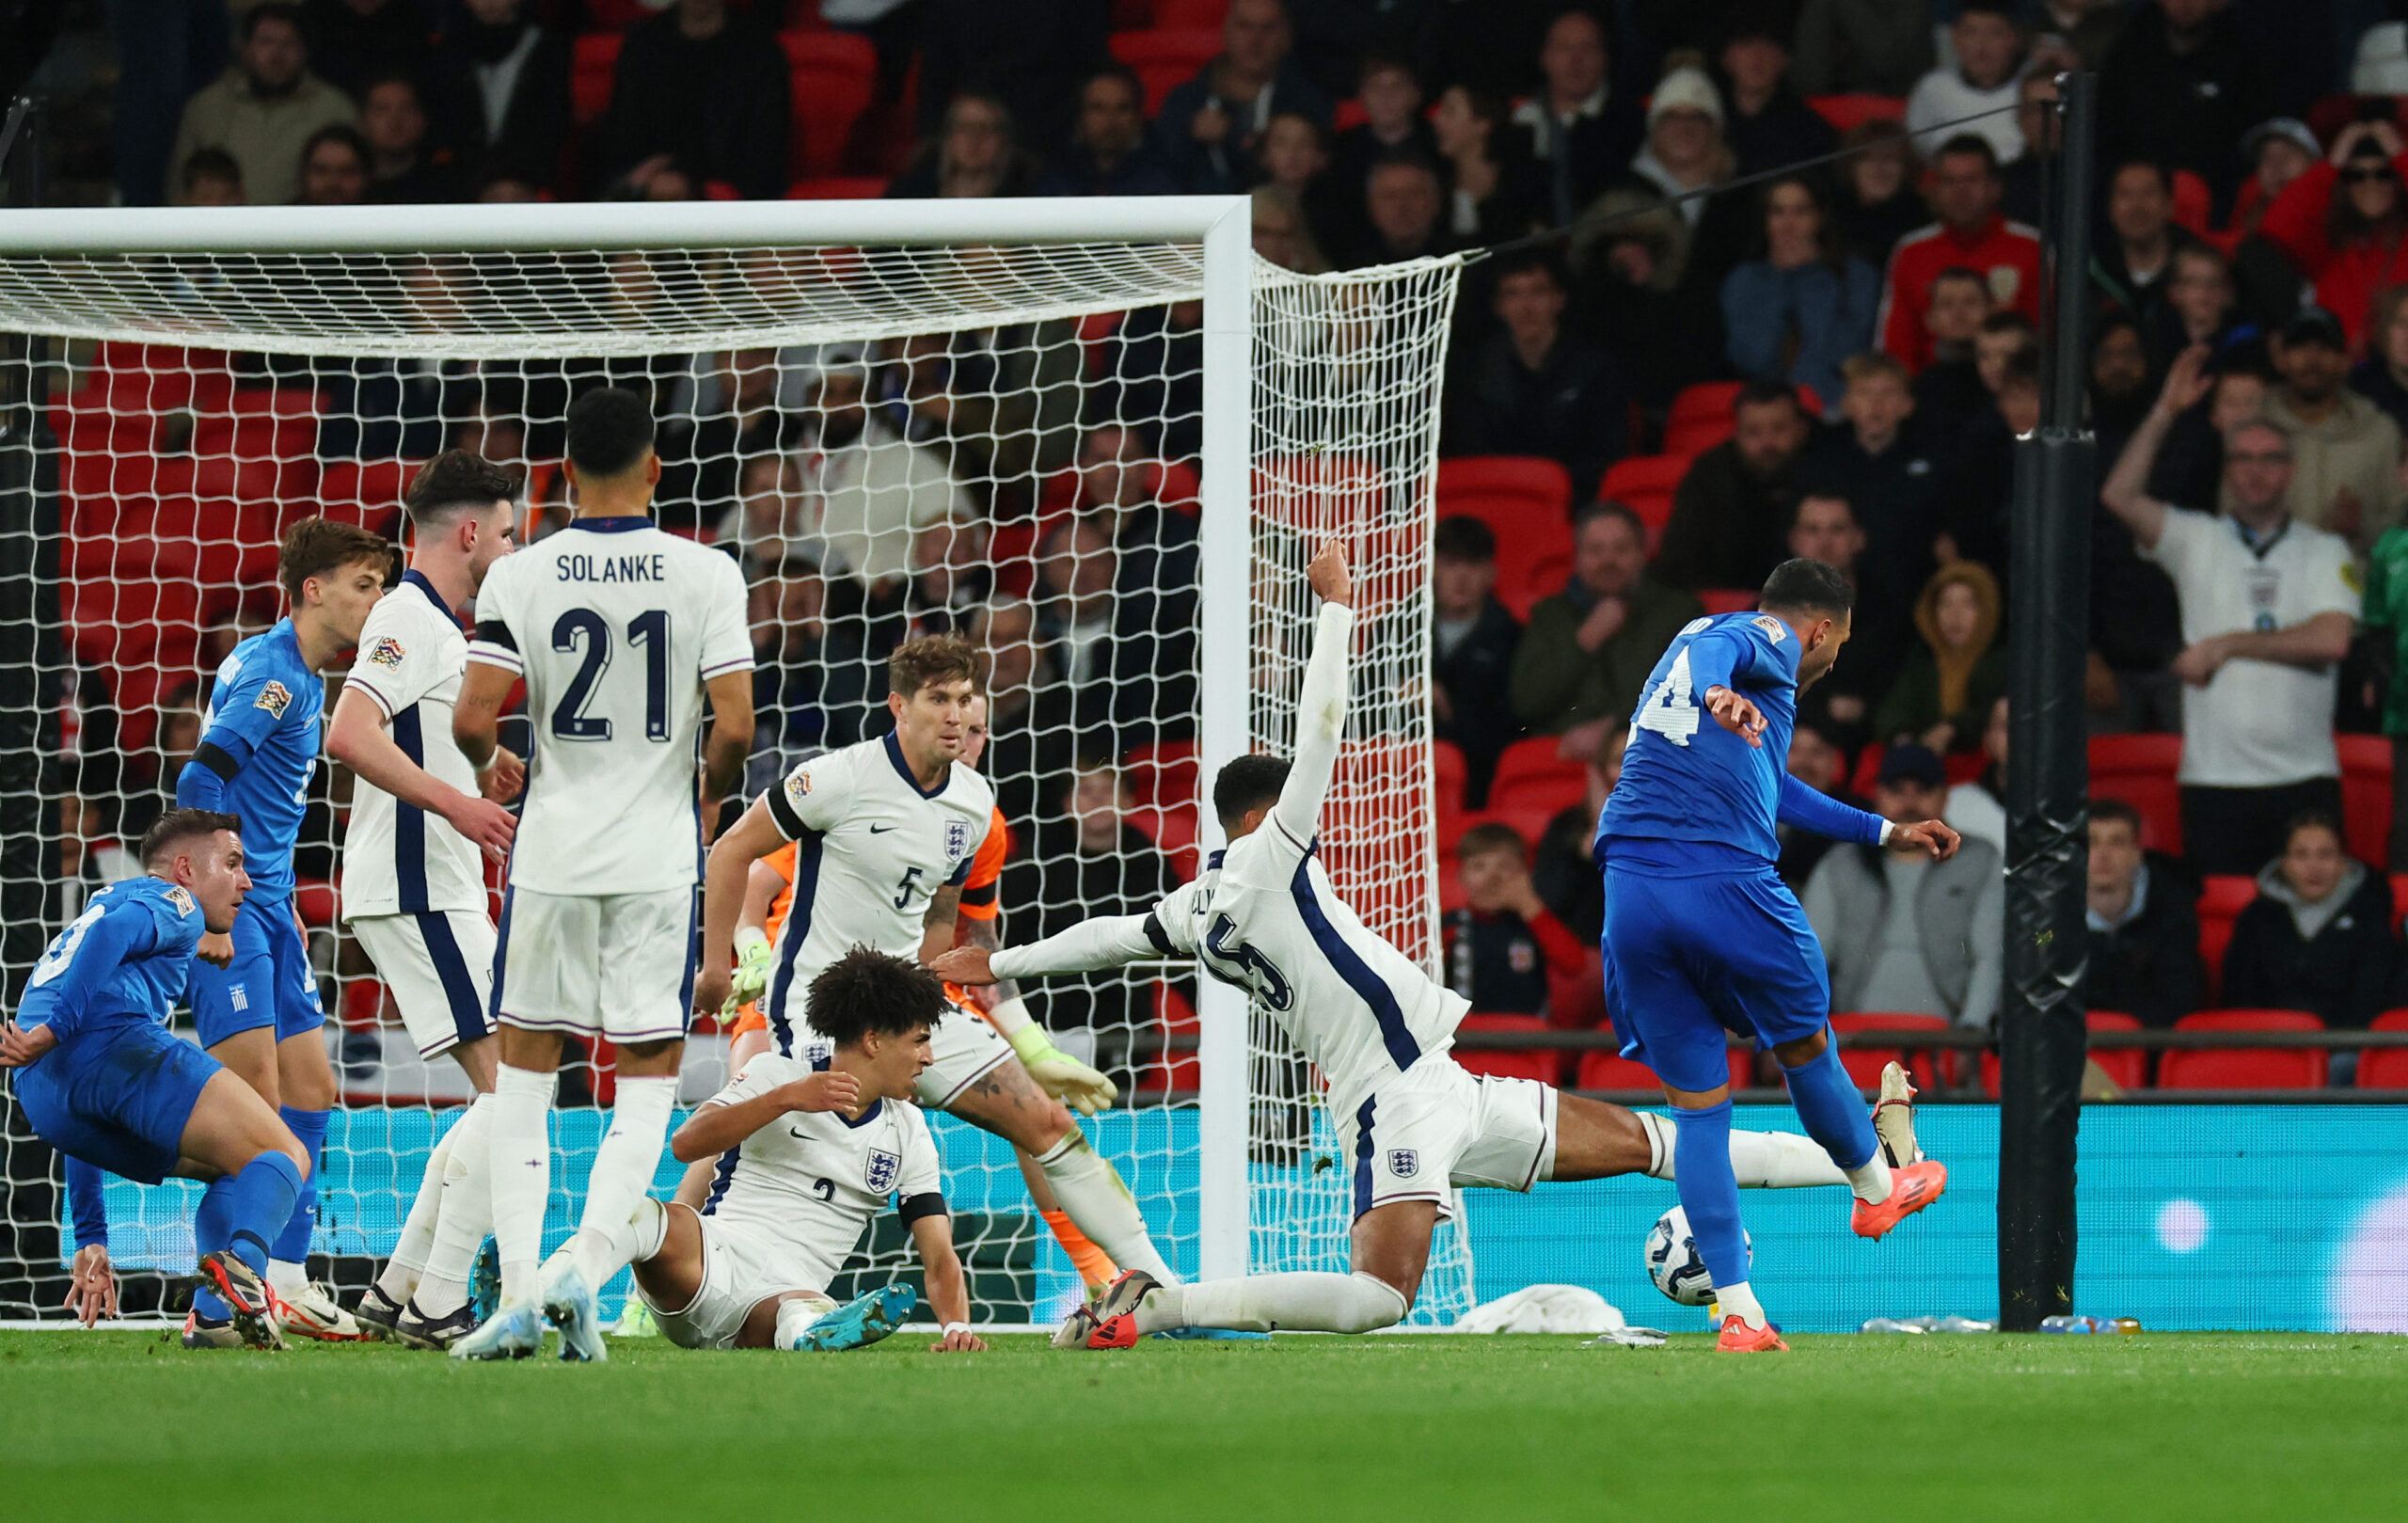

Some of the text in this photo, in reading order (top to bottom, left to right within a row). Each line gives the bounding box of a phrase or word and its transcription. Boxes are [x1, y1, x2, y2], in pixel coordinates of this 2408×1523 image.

[556, 553, 665, 583] SOLANKE
[551, 607, 672, 743] 21
[894, 865, 923, 911] 5
